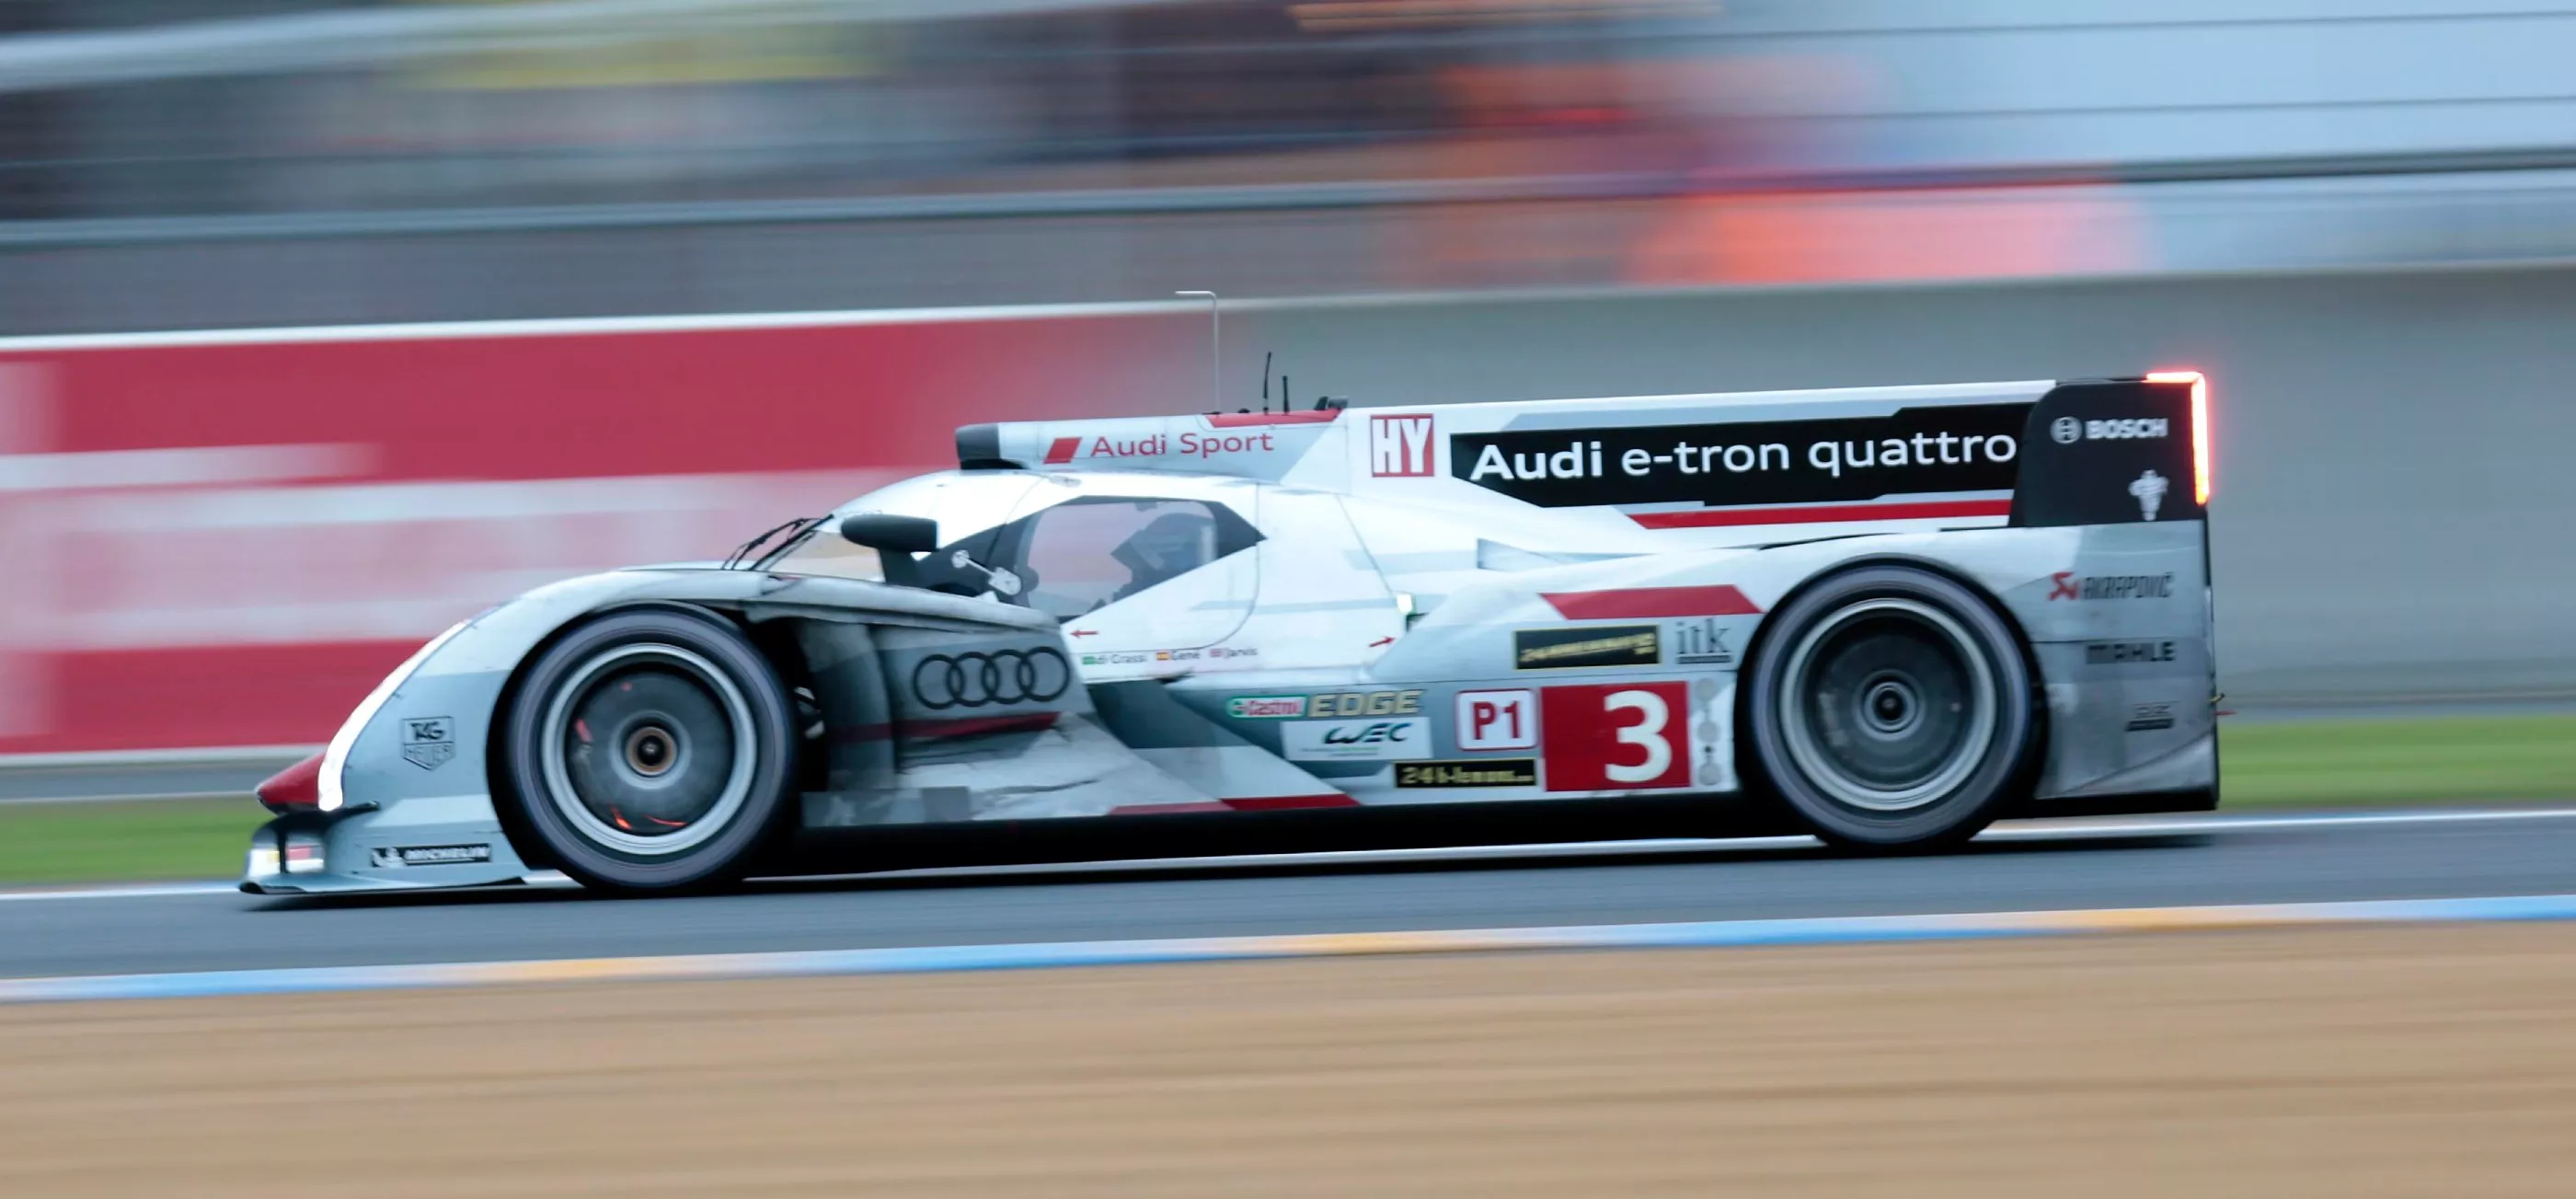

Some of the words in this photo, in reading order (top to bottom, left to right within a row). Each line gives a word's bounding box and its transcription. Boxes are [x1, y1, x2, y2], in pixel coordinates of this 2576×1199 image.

[2086, 418, 2168, 440] BOSCH
[1090, 434, 1167, 457] Audi
[1179, 432, 1274, 459] Sport
[1373, 417, 1432, 475] HY
[1471, 442, 1603, 481] Audi
[1622, 441, 1790, 476] e-tron
[1809, 430, 2018, 478] quattro
[1675, 617, 1731, 654] itk
[2087, 641, 2175, 664] MAHLE
[1246, 698, 1302, 716] Castrol
[1307, 688, 1425, 718] EDGE
[410, 721, 445, 741] TAG
[1323, 722, 1414, 744] WEC
[1473, 700, 1523, 741] P1
[1604, 690, 1673, 783] 3
[404, 846, 490, 859] MICHELIN
